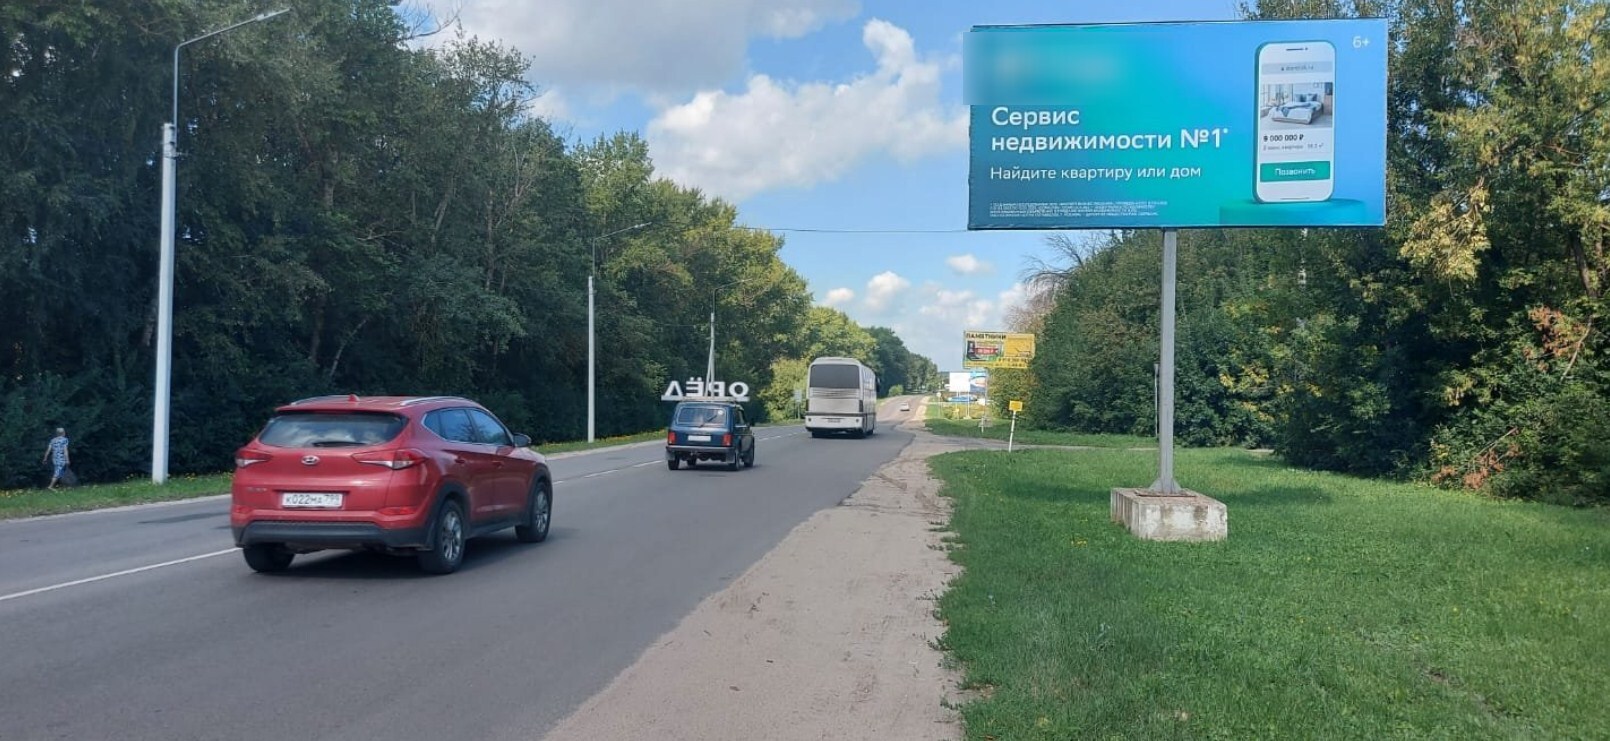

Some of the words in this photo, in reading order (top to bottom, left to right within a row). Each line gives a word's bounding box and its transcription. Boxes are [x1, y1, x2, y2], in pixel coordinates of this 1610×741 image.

[1352, 36, 1370, 48] 6+
[991, 106, 1080, 129] Сервис
[991, 134, 1172, 154] недвижимости
[990, 166, 1057, 181] Найдите
[1061, 167, 1133, 181] квартиру
[1137, 167, 1166, 178] или
[1169, 167, 1202, 179] дом
[1275, 168, 1316, 176] Позвонить
